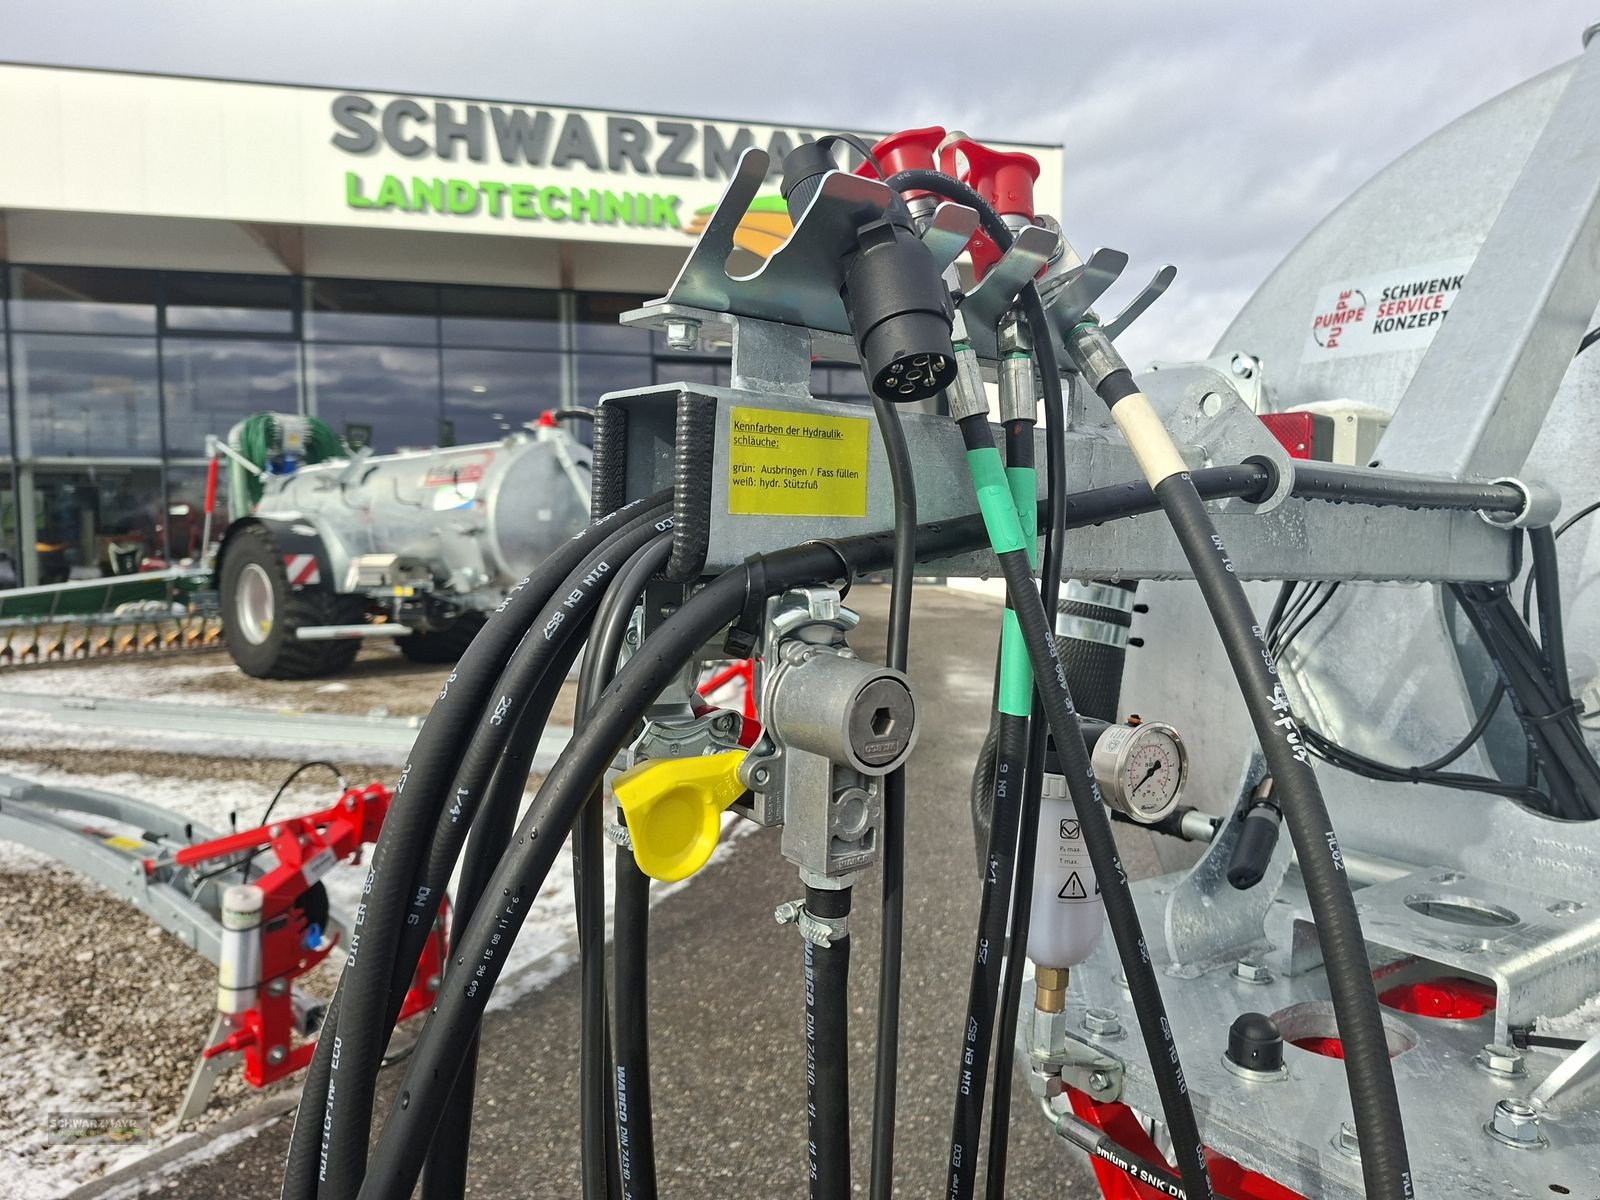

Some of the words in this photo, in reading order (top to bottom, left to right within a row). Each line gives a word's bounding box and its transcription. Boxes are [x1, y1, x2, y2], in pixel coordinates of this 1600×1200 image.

[330, 95, 882, 185] SCHWARZMA
[344, 171, 681, 229] LANDTECHNIK
[1380, 275, 1464, 303] SCHWENK
[1313, 306, 1366, 329] PUMPE
[1376, 294, 1445, 318] SERVICE
[1373, 310, 1450, 335] KONZEPT
[733, 435, 780, 448] schläuche:
[734, 420, 784, 435] Kennfarben
[786, 426, 800, 435] der
[802, 427, 844, 439] Hydraulik-
[733, 463, 756, 475] grün:
[761, 465, 808, 477] Ausbringen
[817, 468, 834, 478] Fass
[836, 469, 859, 479] füllen
[733, 476, 757, 487] weiß:
[759, 478, 781, 490] hydr.
[783, 479, 819, 490] Stützfuß
[654, 515, 676, 532] CO
[1210, 534, 1225, 551] DN
[582, 561, 612, 587] DIN
[563, 588, 584, 609] EN
[542, 611, 566, 641] 857
[489, 695, 513, 727] 2SC
[999, 763, 1009, 773] 6
[997, 779, 1007, 798] DN
[414, 886, 432, 908] DN
[977, 937, 989, 965] 2SC
[331, 1036, 343, 1070] ECO
[347, 934, 361, 967] DIN
[355, 903, 367, 926] EN
[806, 1011, 815, 1041] DIN
[967, 1015, 980, 1043] 857
[806, 1043, 816, 1086] 74310
[964, 1047, 975, 1066] EN
[616, 1066, 628, 1123] WABCO
[960, 1071, 972, 1096] DIN
[619, 1125, 629, 1147] DIN
[621, 1149, 631, 1181] 74310
[952, 1143, 963, 1168] ECO
[1129, 1164, 1138, 1177] 2
[1139, 1169, 1168, 1193] SNK
[1168, 1183, 1188, 1200] DN
